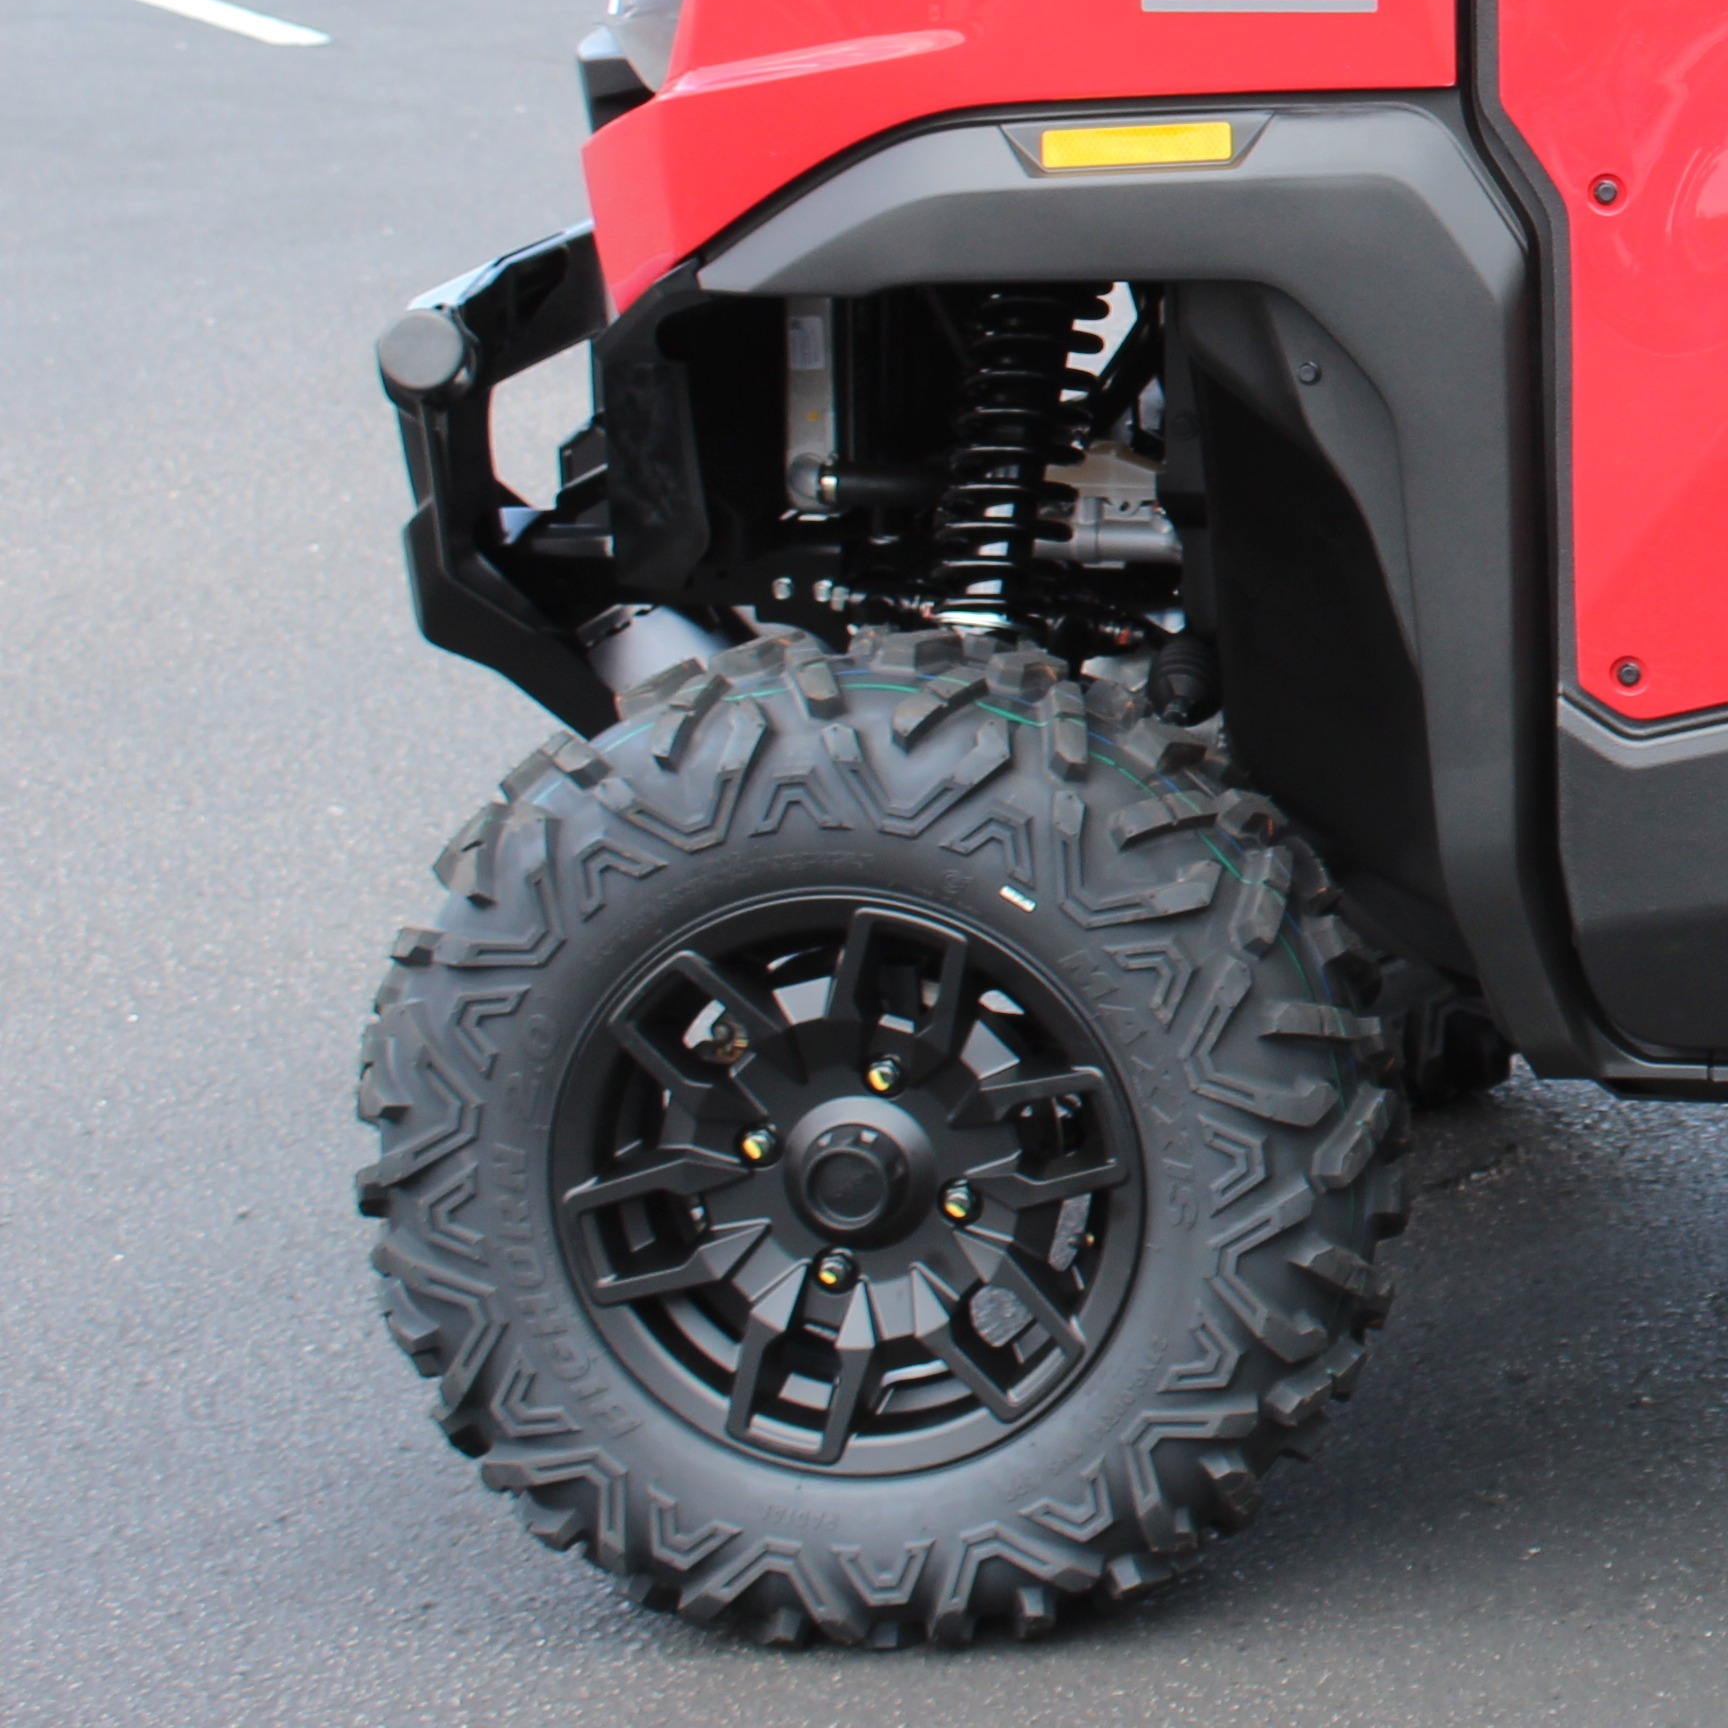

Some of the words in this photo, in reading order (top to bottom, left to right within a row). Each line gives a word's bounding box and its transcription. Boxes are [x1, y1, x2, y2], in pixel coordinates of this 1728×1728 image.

[502, 1011, 561, 1121] 2.0
[1058, 948, 1194, 1229] MAXXIS
[492, 1142, 644, 1449] BIGHORN
